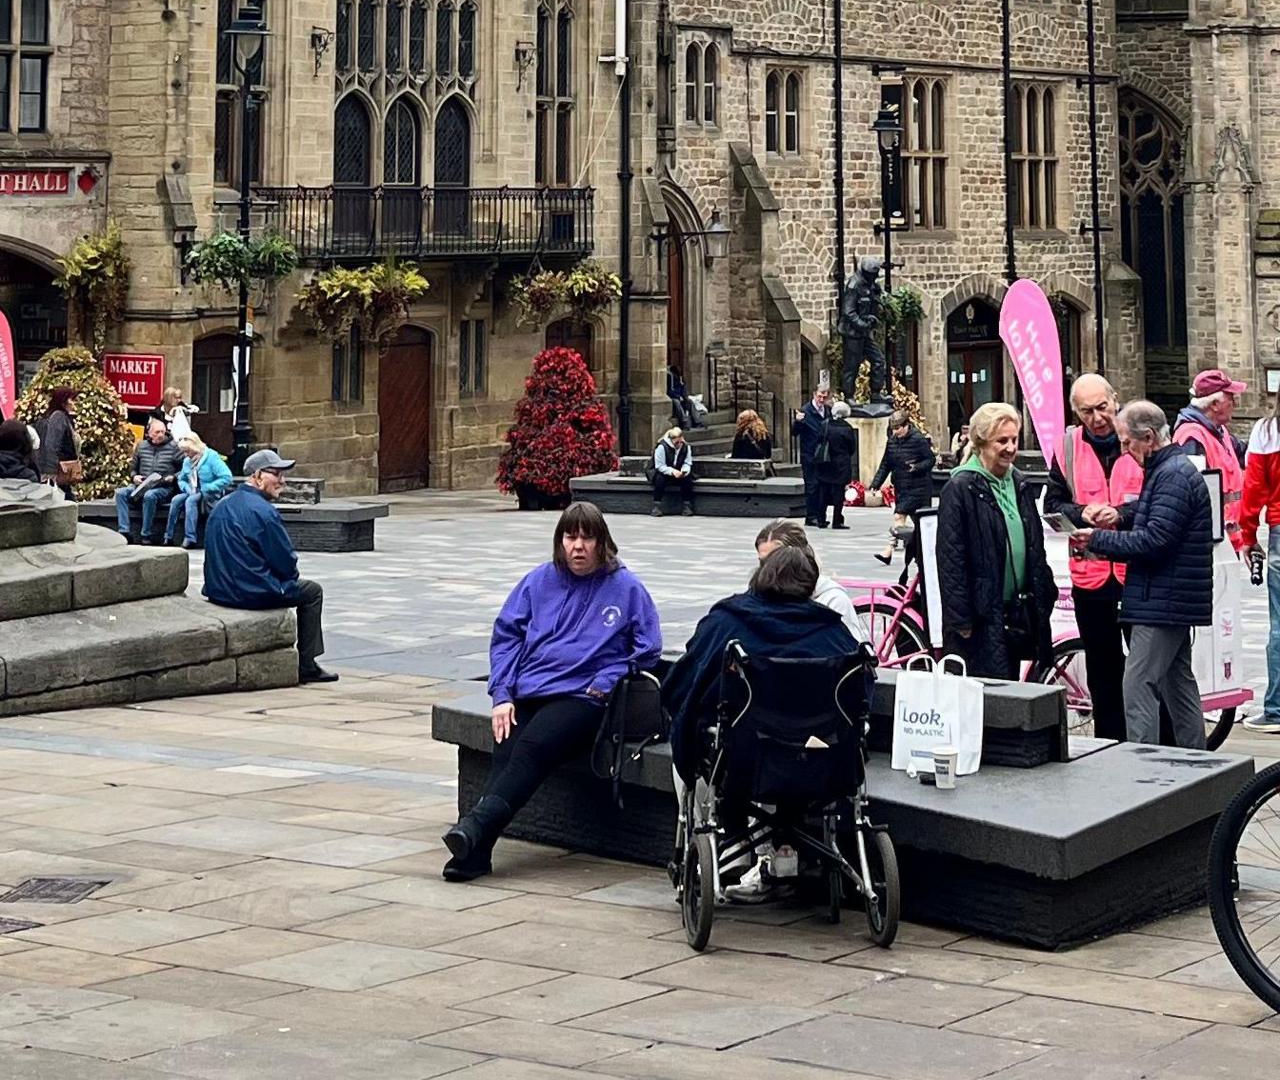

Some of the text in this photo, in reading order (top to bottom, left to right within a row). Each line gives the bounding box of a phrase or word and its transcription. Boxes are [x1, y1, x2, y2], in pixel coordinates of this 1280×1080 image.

[14, 174, 67, 191] HALL
[1025, 320, 1052, 382] Here
[110, 360, 157, 376] MARKET
[1008, 320, 1044, 409] to Help
[118, 381, 148, 395] HALL
[903, 706, 944, 728] Look,
[904, 727, 944, 737] NO PLASTIC
